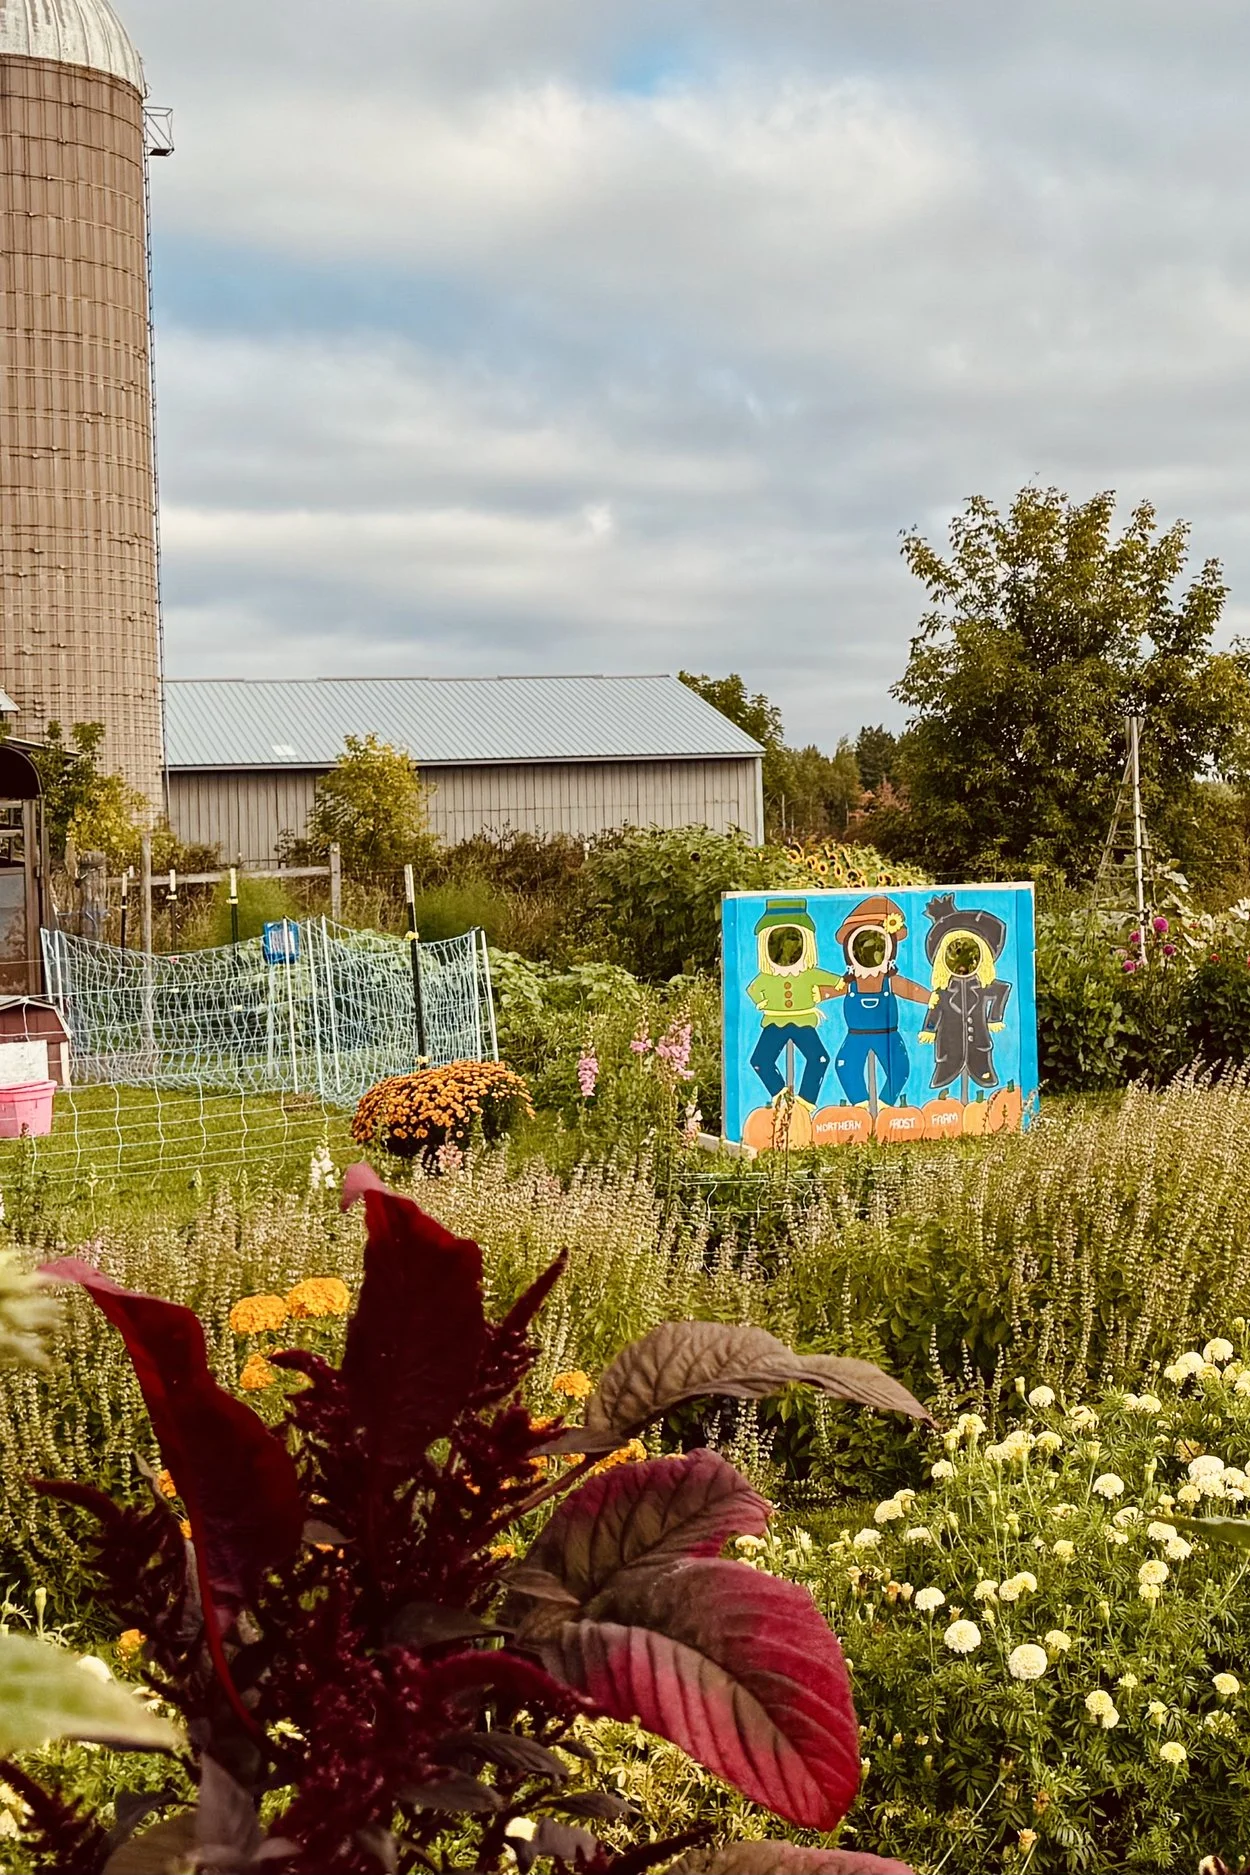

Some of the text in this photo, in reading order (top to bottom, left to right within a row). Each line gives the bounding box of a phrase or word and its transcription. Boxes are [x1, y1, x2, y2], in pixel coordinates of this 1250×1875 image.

[816, 1112, 958, 1132] NORTHERN FROST FARM
